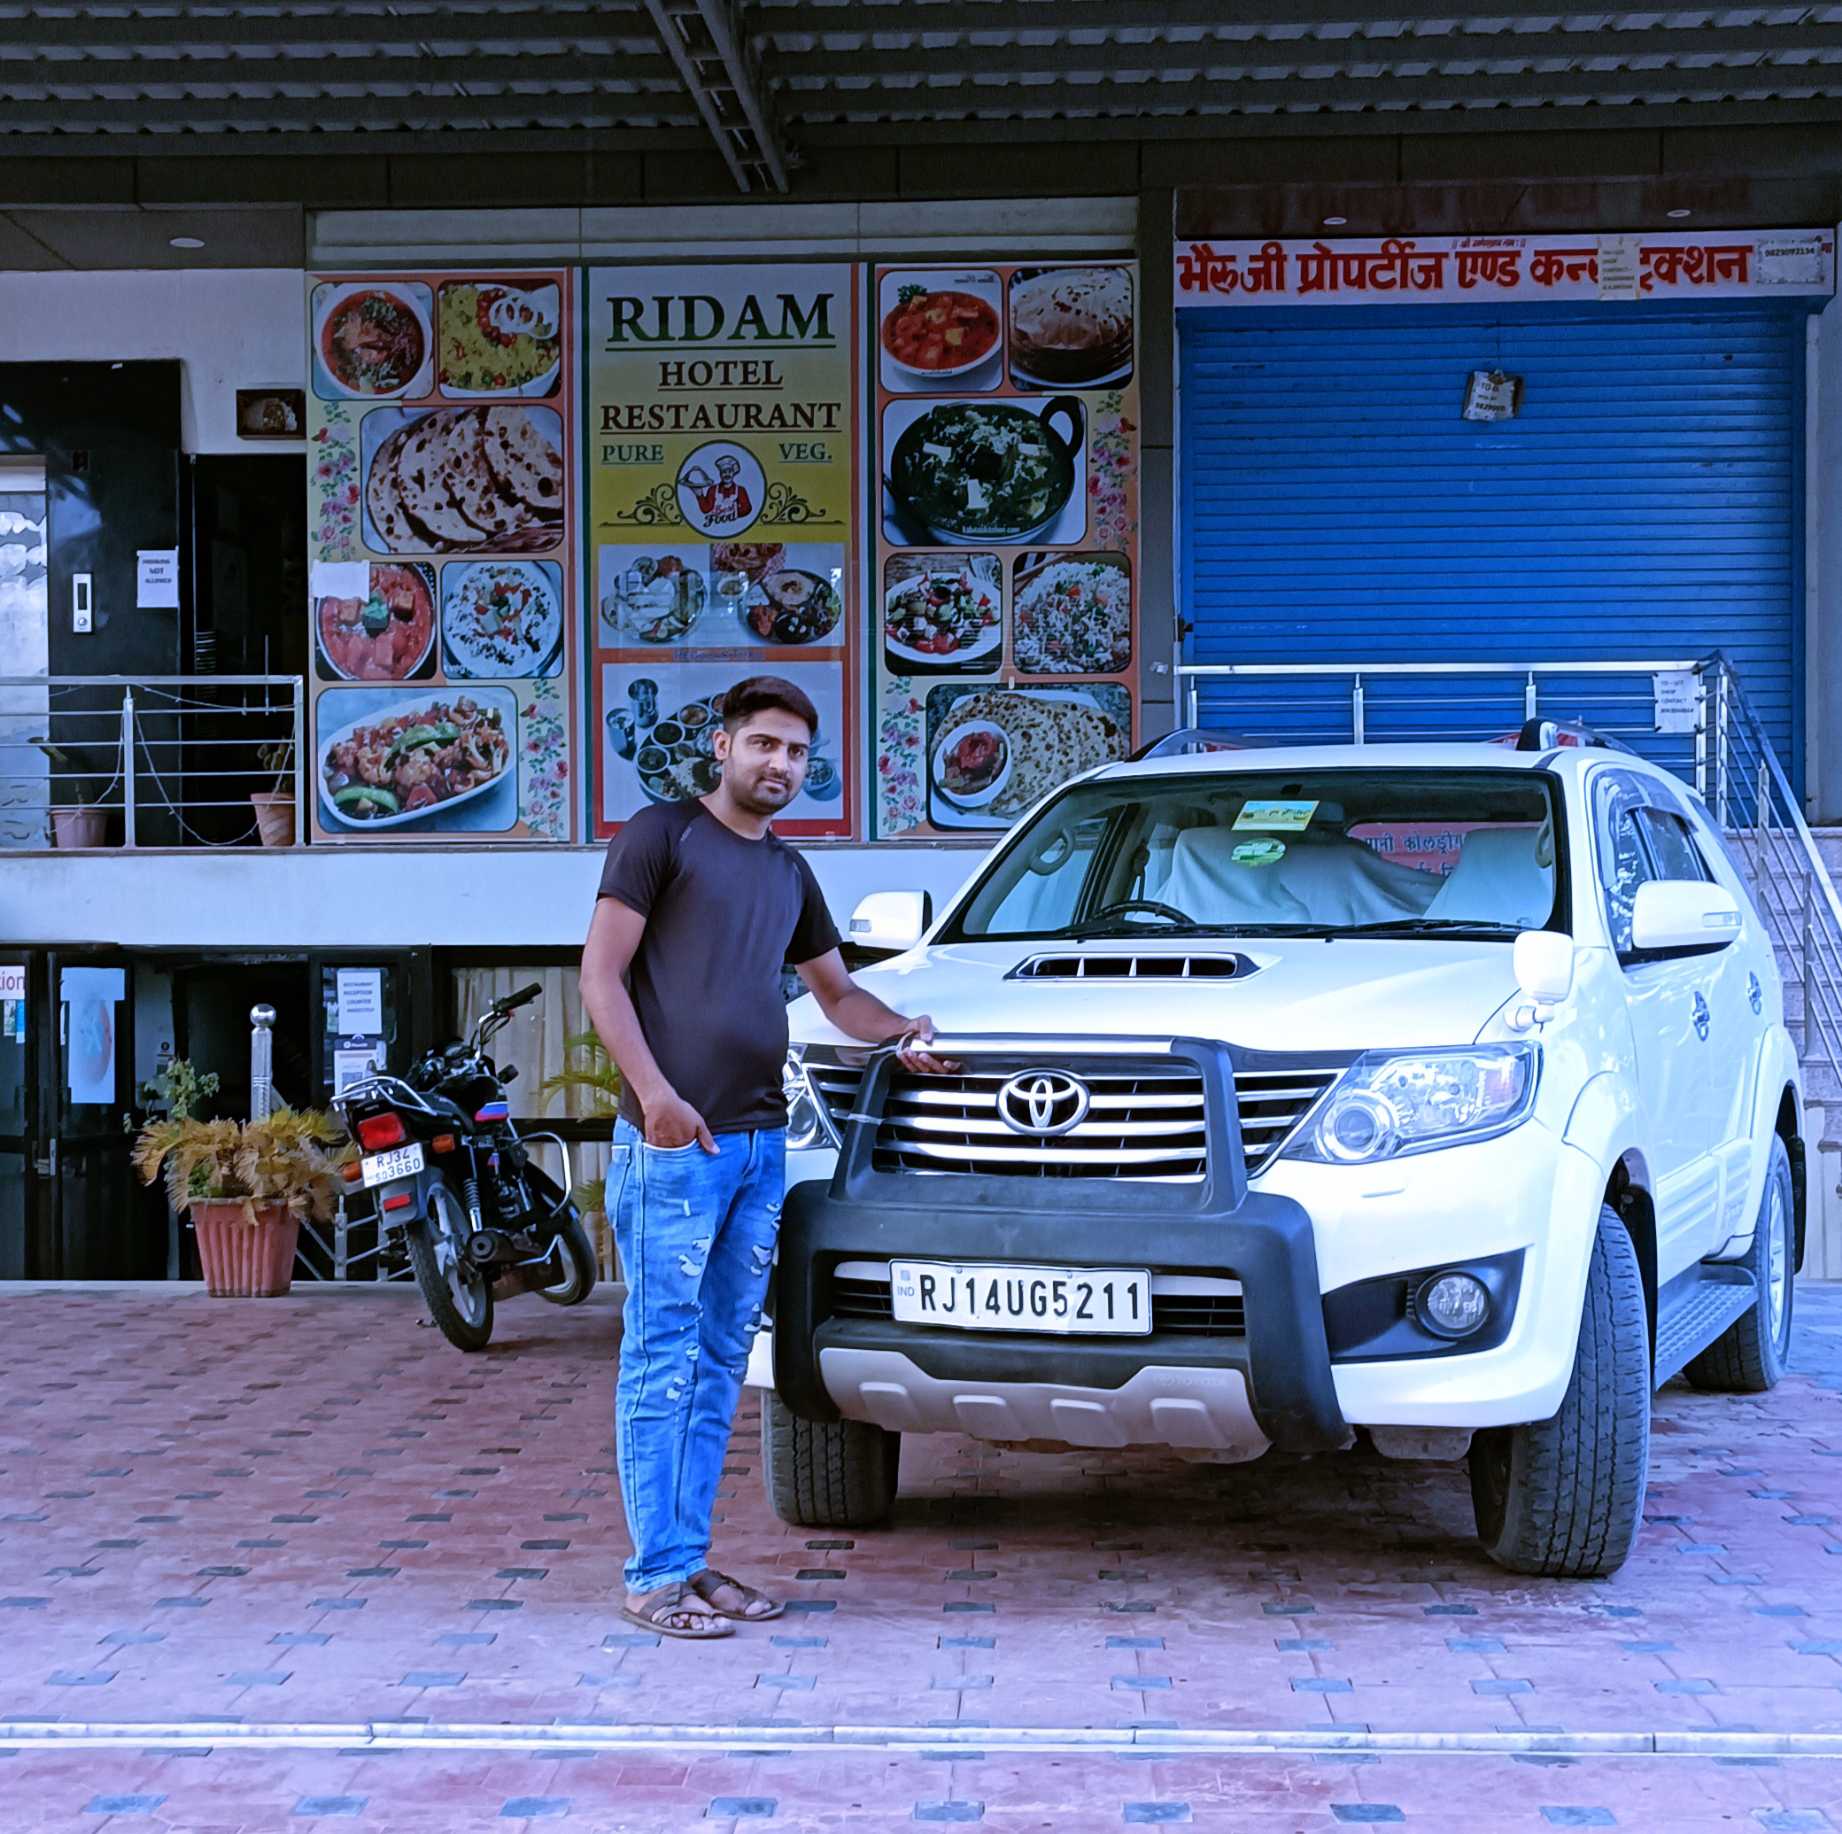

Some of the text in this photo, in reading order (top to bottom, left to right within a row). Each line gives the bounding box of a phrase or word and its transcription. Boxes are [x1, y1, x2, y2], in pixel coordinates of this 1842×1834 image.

[1455, 250, 1521, 289] एण्ड
[606, 293, 836, 342] RIDAM
[658, 360, 784, 387] HOTEL
[600, 403, 841, 430] RESTAURANT
[602, 443, 833, 462] PURE VEG.
[703, 511, 738, 527] Food
[149, 567, 165, 575] NOT
[897, 1274, 1138, 1320] IND RJ14UG5211
